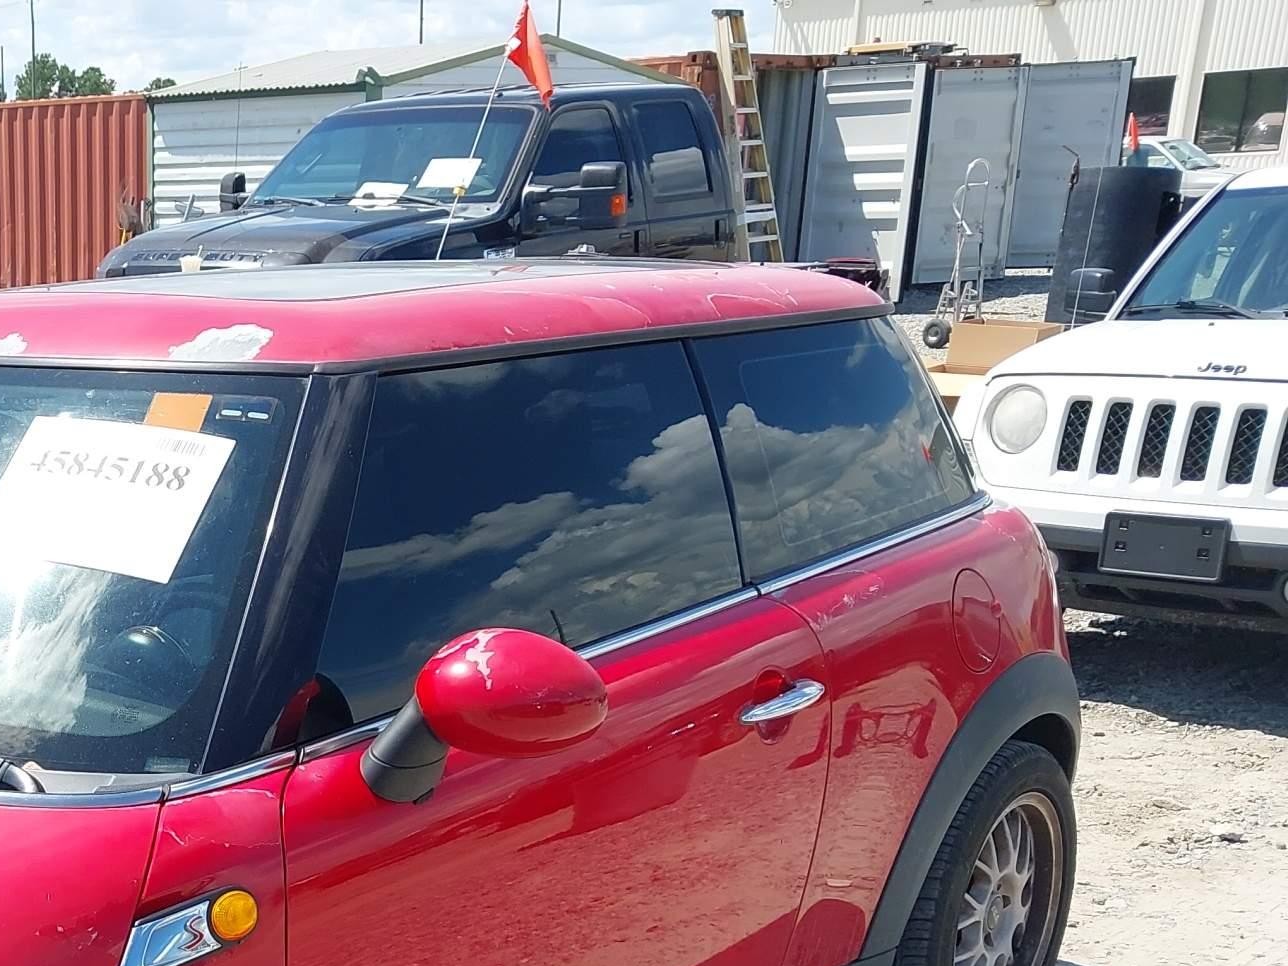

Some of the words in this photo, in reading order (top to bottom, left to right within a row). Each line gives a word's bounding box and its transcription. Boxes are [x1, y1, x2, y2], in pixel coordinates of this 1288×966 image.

[202, 252, 264, 263] DUTY
[1197, 361, 1247, 376] Jeep
[29, 450, 191, 491] 45845188
